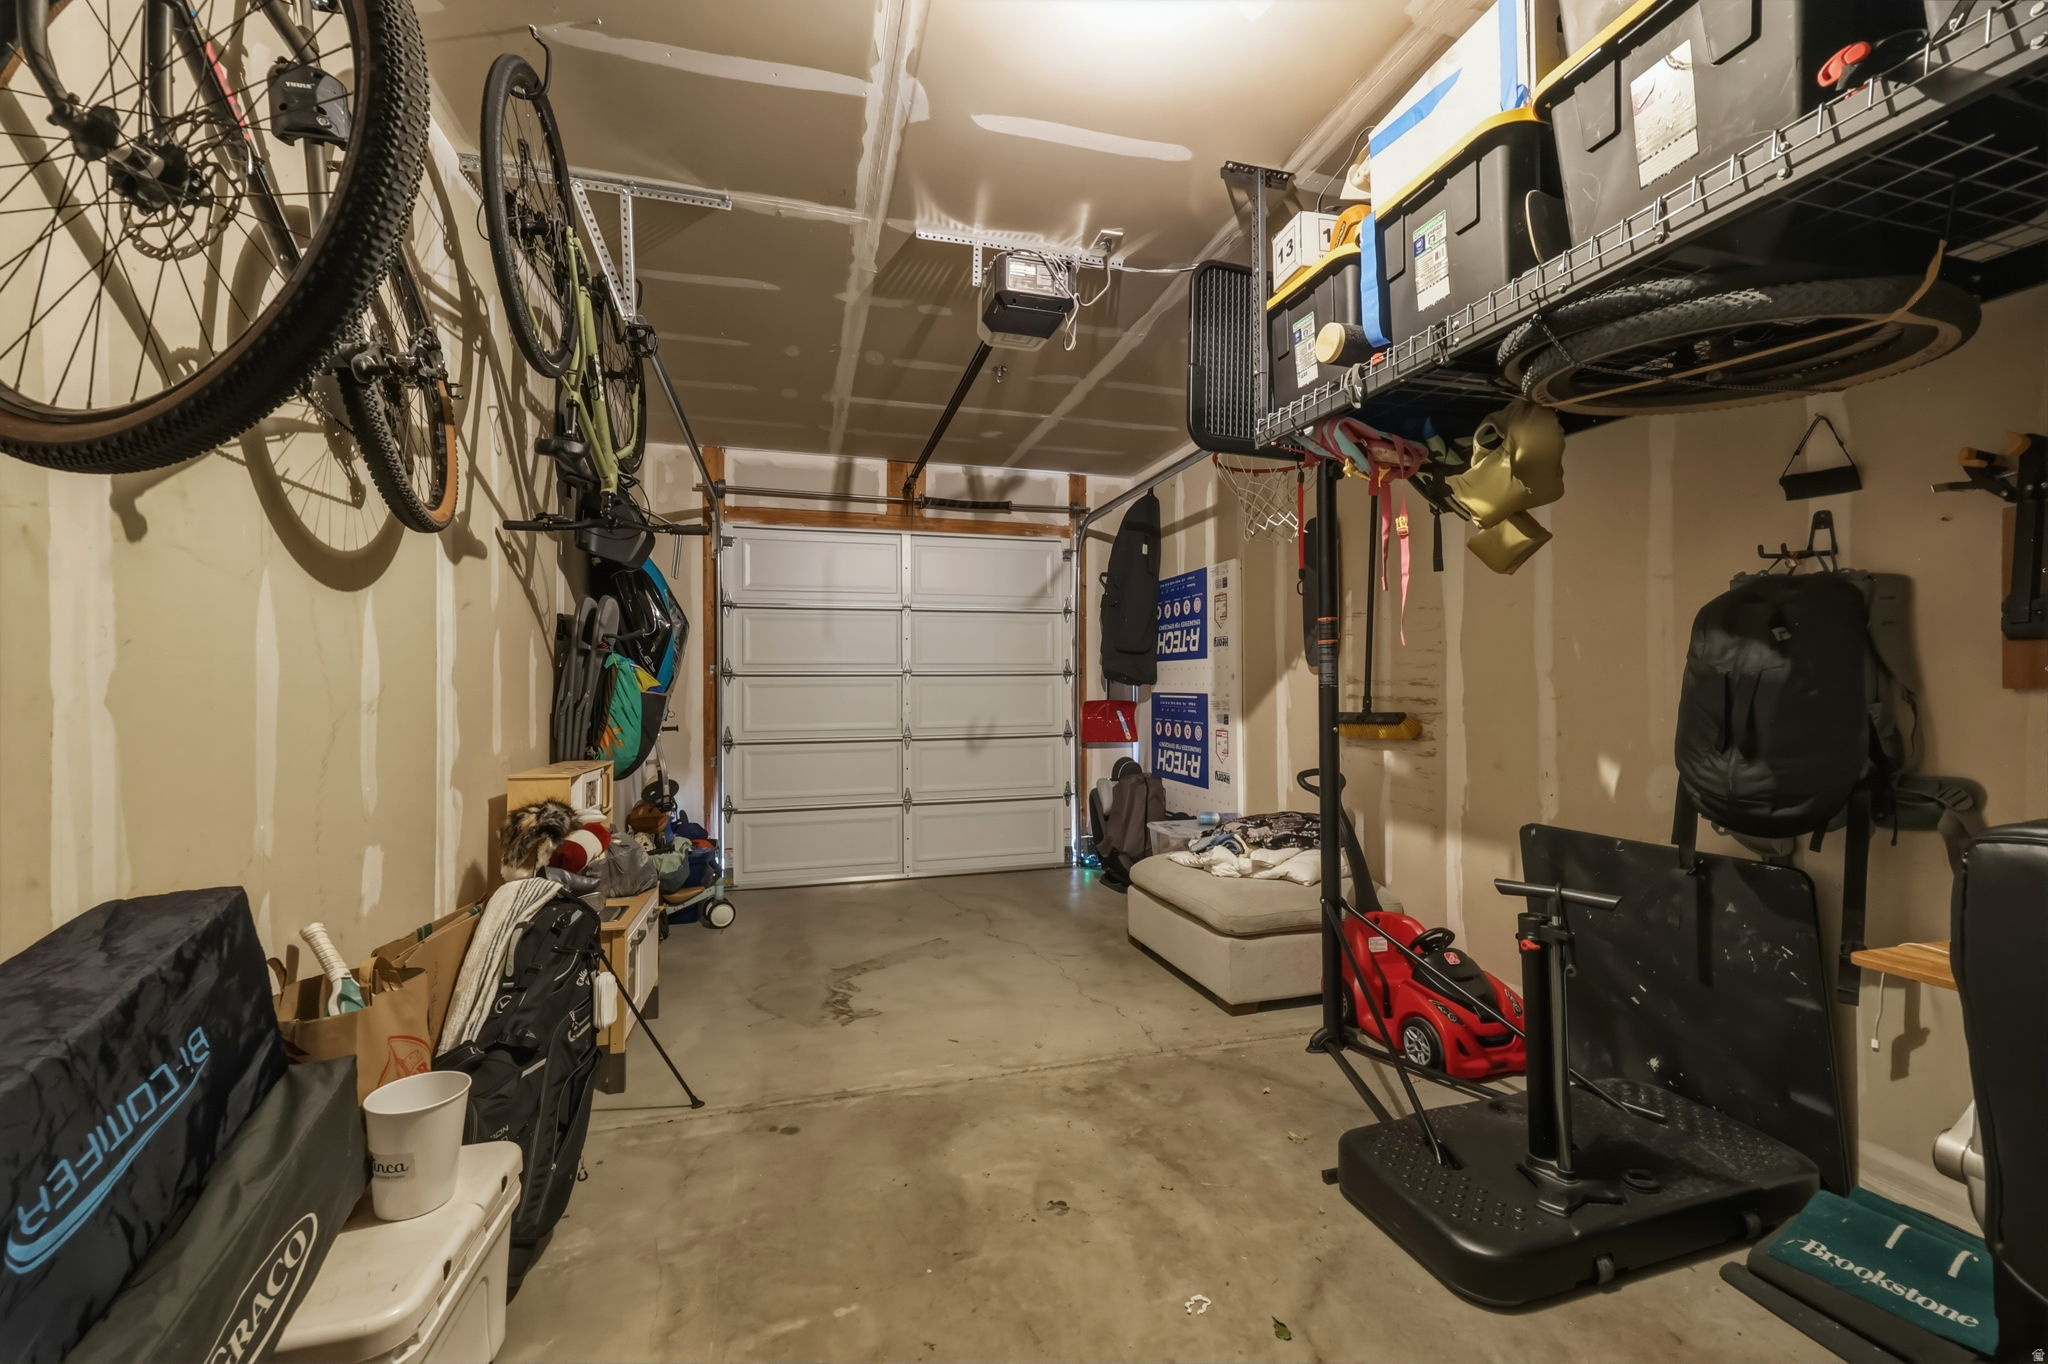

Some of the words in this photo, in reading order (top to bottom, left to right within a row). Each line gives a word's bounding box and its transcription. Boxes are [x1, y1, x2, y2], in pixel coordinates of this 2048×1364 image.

[1277, 238, 1294, 264] 13
[1156, 627, 1201, 655] R-TECH
[1156, 748, 1202, 779] R-TECH
[1799, 1238, 1980, 1328] Brookstone
